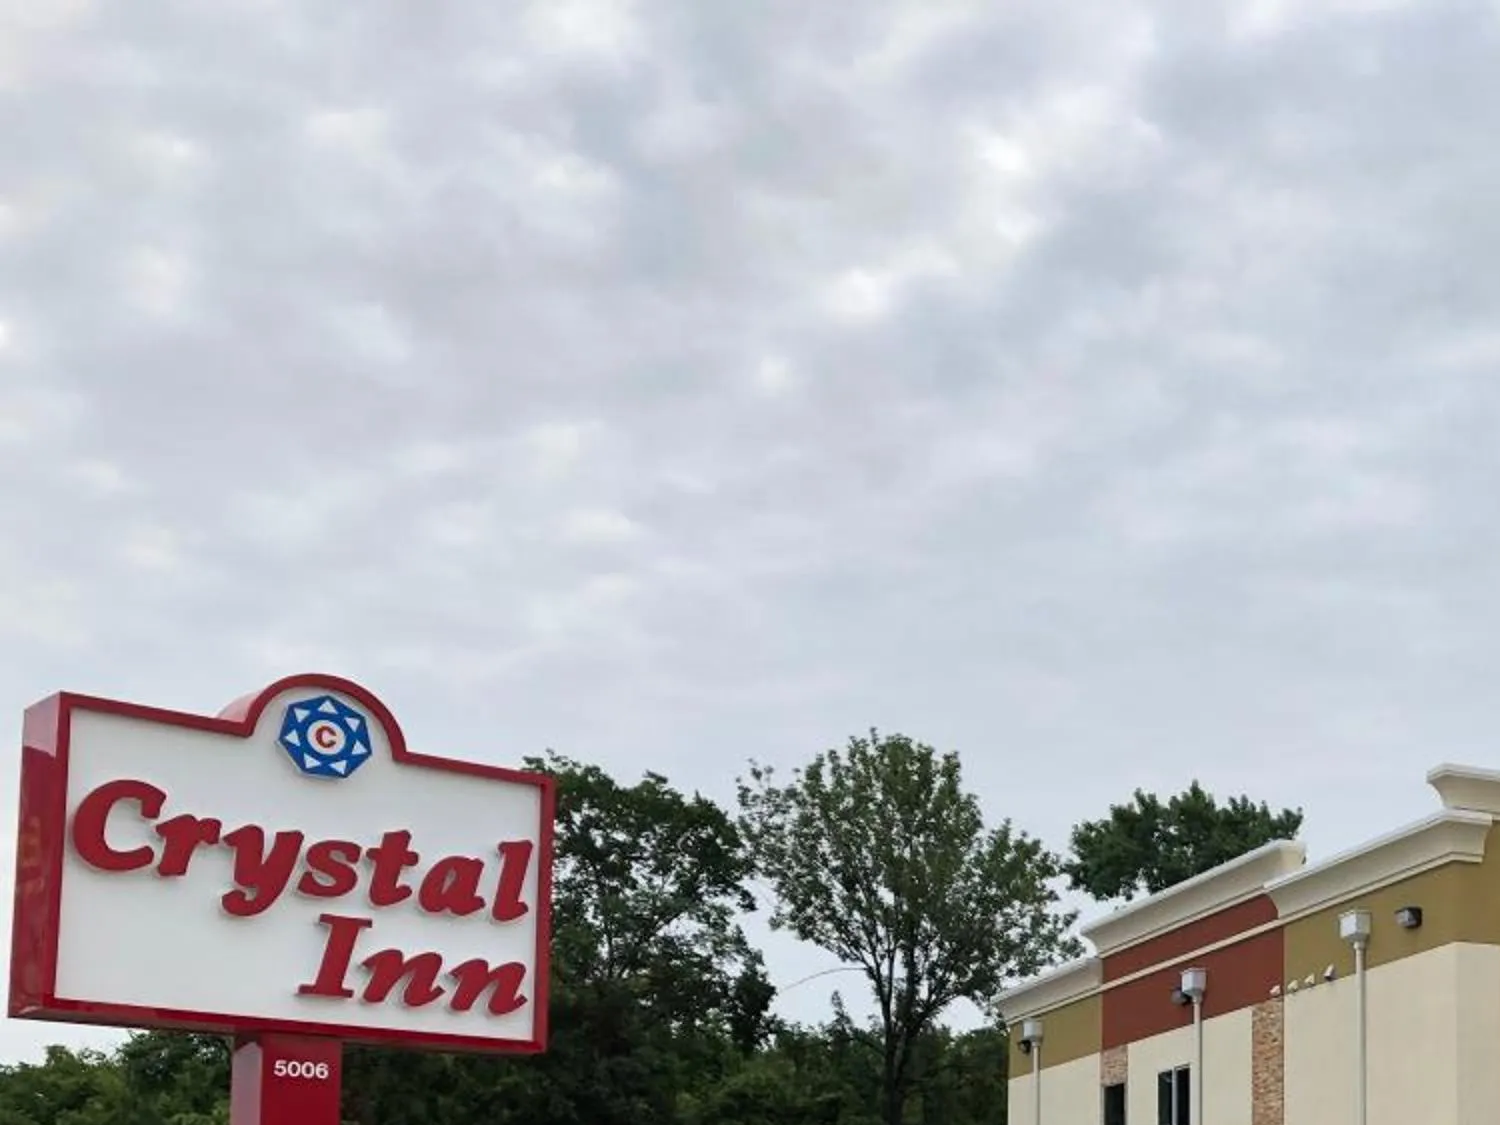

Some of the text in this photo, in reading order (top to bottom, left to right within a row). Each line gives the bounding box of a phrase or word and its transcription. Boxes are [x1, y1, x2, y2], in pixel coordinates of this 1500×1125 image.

[315, 726, 337, 748] C
[73, 779, 533, 922] Crystal
[299, 913, 528, 1015] Inn
[273, 1059, 329, 1079] 5006
